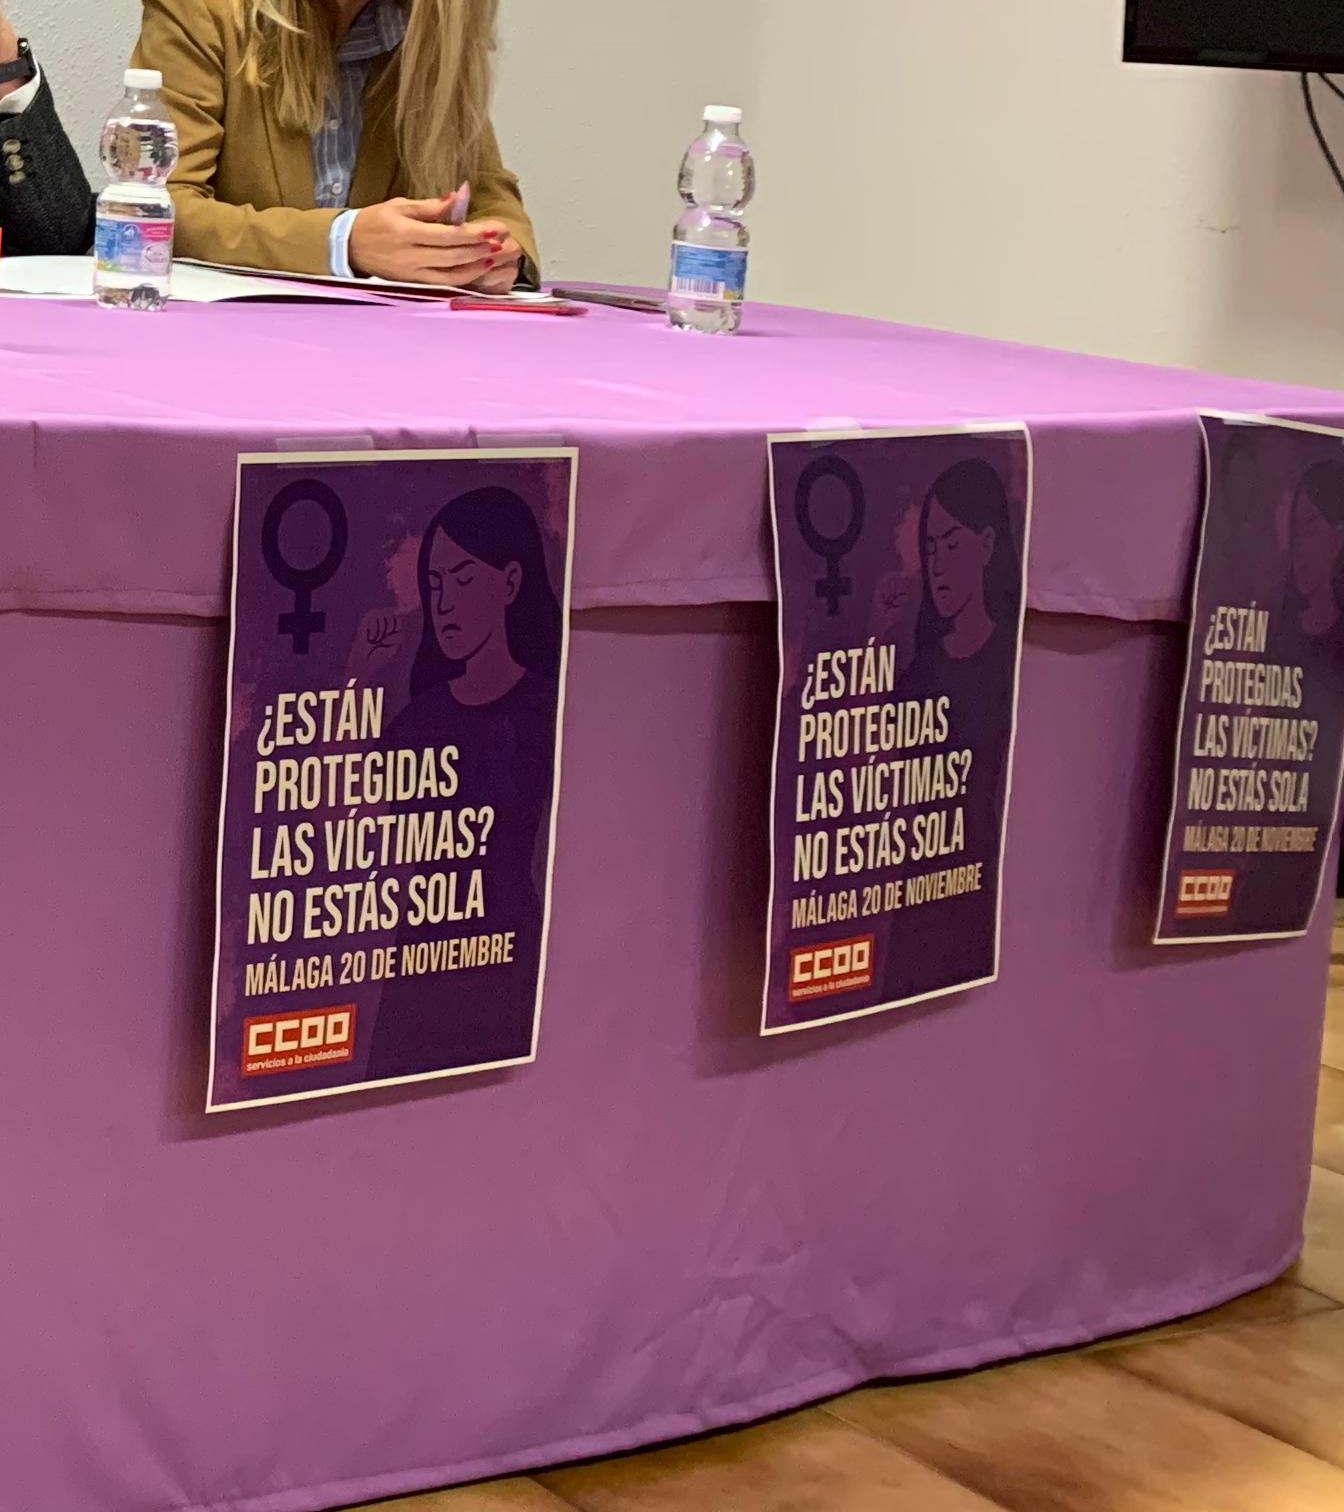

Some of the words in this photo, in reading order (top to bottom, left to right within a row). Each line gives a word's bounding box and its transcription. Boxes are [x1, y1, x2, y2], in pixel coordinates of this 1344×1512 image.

[1204, 601, 1268, 655] ¿ESTÁN
[802, 637, 895, 709] ¿ESTÁN
[1200, 660, 1302, 708] PROTEGIDAS
[257, 679, 383, 756] ¿ESTÁN
[799, 696, 950, 761] PROTEGIDAS
[1194, 714, 1229, 757] LAS
[1232, 709, 1318, 761] VÍCTIMAS?
[254, 745, 459, 813] PROTEGIDAS
[796, 769, 843, 822] LAS
[852, 749, 971, 813] VÍCTIMAS?
[1188, 768, 1214, 810] NO
[1216, 763, 1266, 811] ESTÁS
[1268, 770, 1309, 811] SOLA
[251, 823, 314, 879] LAS
[325, 806, 494, 871] VÍCTIMAS?
[794, 831, 828, 881] NO
[835, 812, 906, 875] ESTÁS
[911, 807, 963, 860] SOLA
[248, 890, 293, 944] NO
[304, 871, 399, 938] ESTÁS
[408, 870, 484, 925] SOLA
[792, 890, 857, 928] MÁLAGA
[862, 885, 881, 916] 20
[885, 881, 902, 911] DE
[906, 863, 982, 906] NOVIEMBRE
[245, 954, 333, 996] MÁLAGA
[340, 951, 365, 984] 20
[371, 947, 397, 980] DE
[402, 932, 515, 976] NOVIEMBRE
[793, 941, 870, 983] CCOO
[248, 1012, 350, 1056] CCOO
